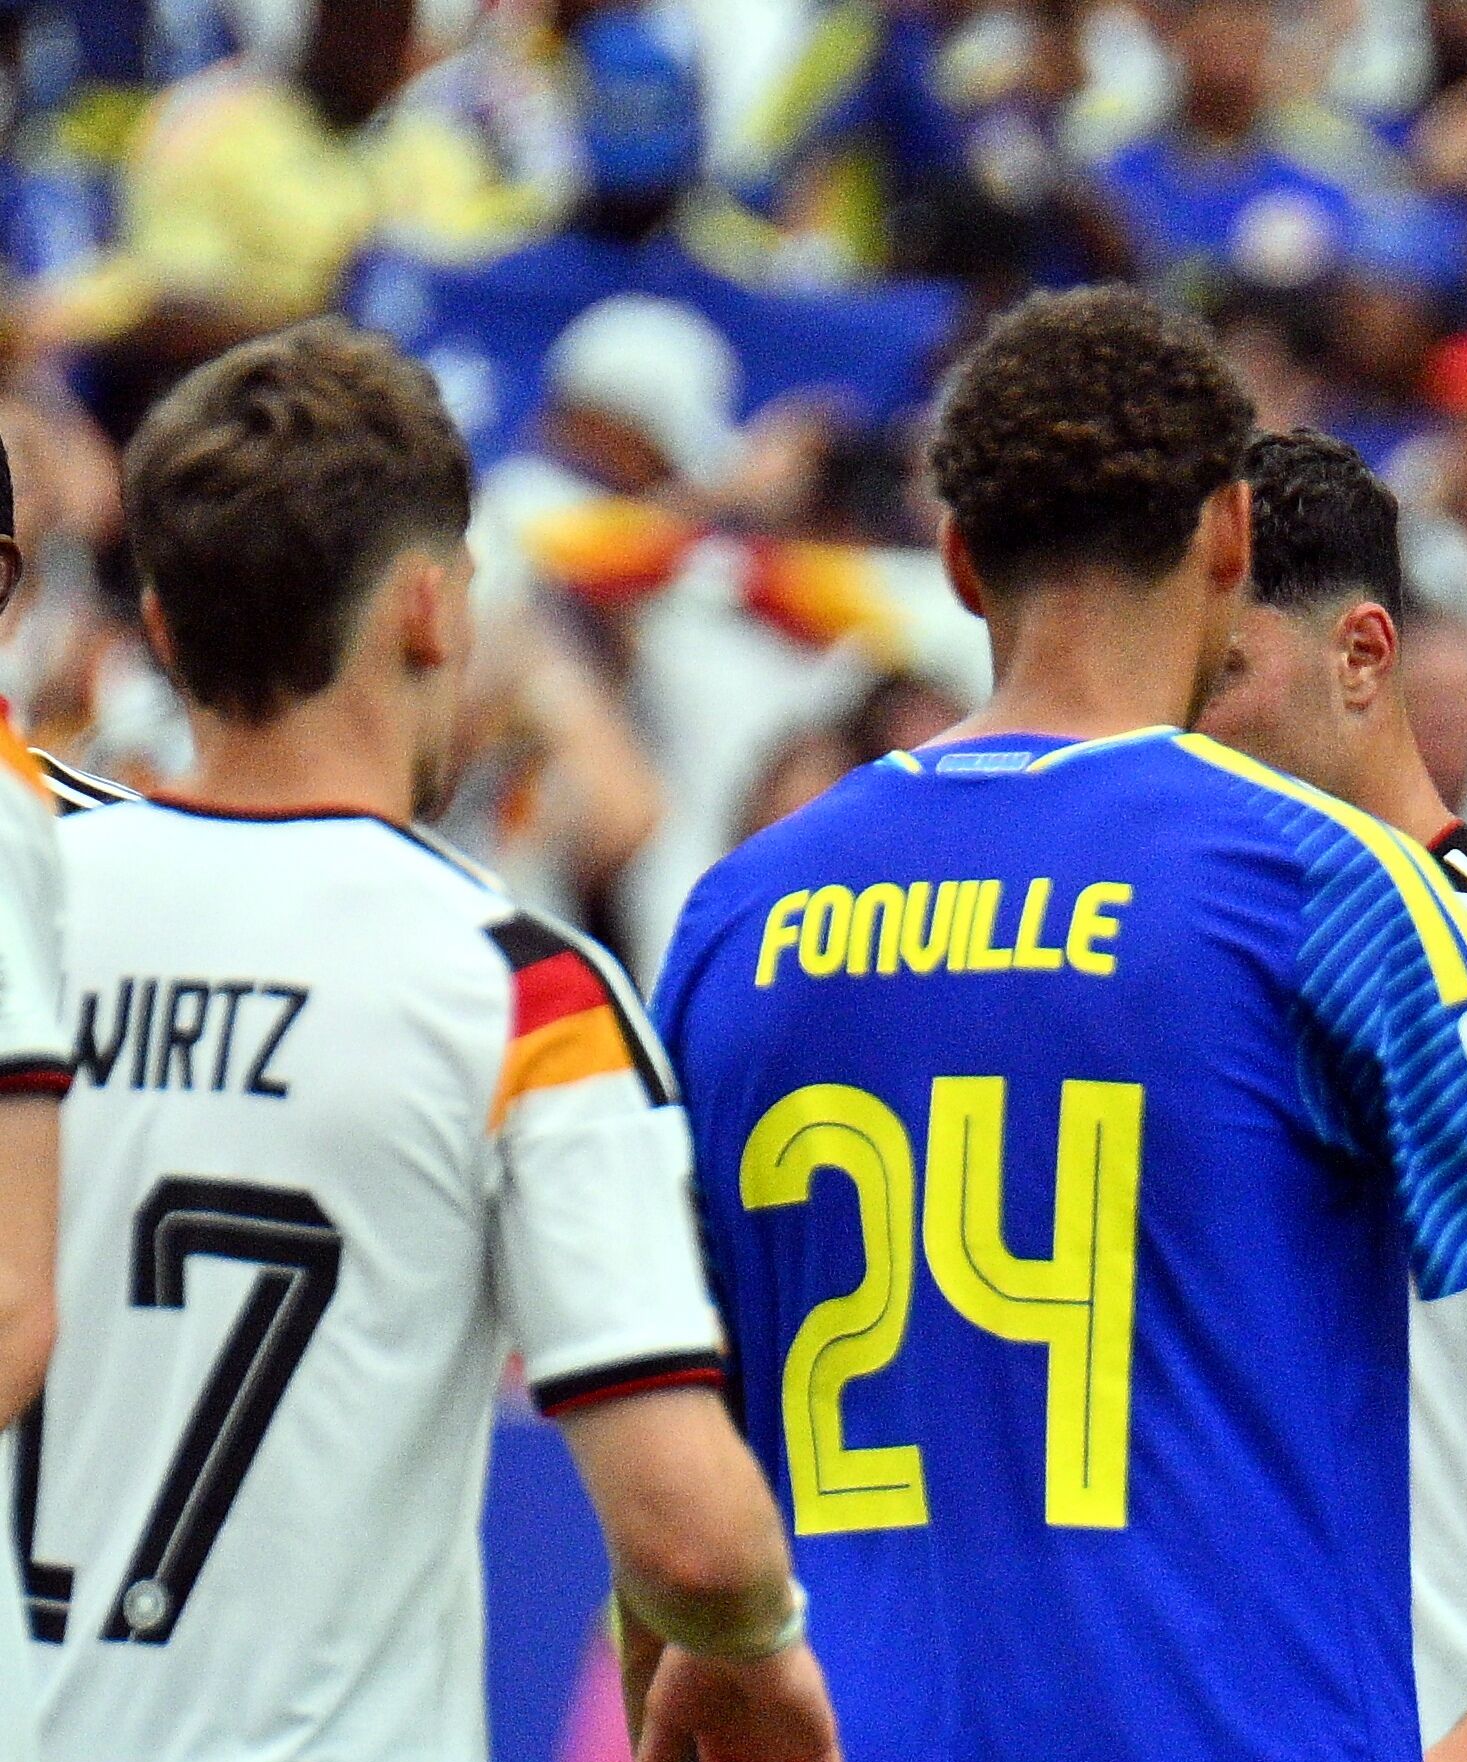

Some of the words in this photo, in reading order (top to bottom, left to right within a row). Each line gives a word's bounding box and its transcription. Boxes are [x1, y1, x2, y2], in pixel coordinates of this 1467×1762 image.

[755, 876, 1133, 988] FONVILLE
[77, 978, 310, 1098] WIRTZ
[740, 1076, 1146, 1536] 24
